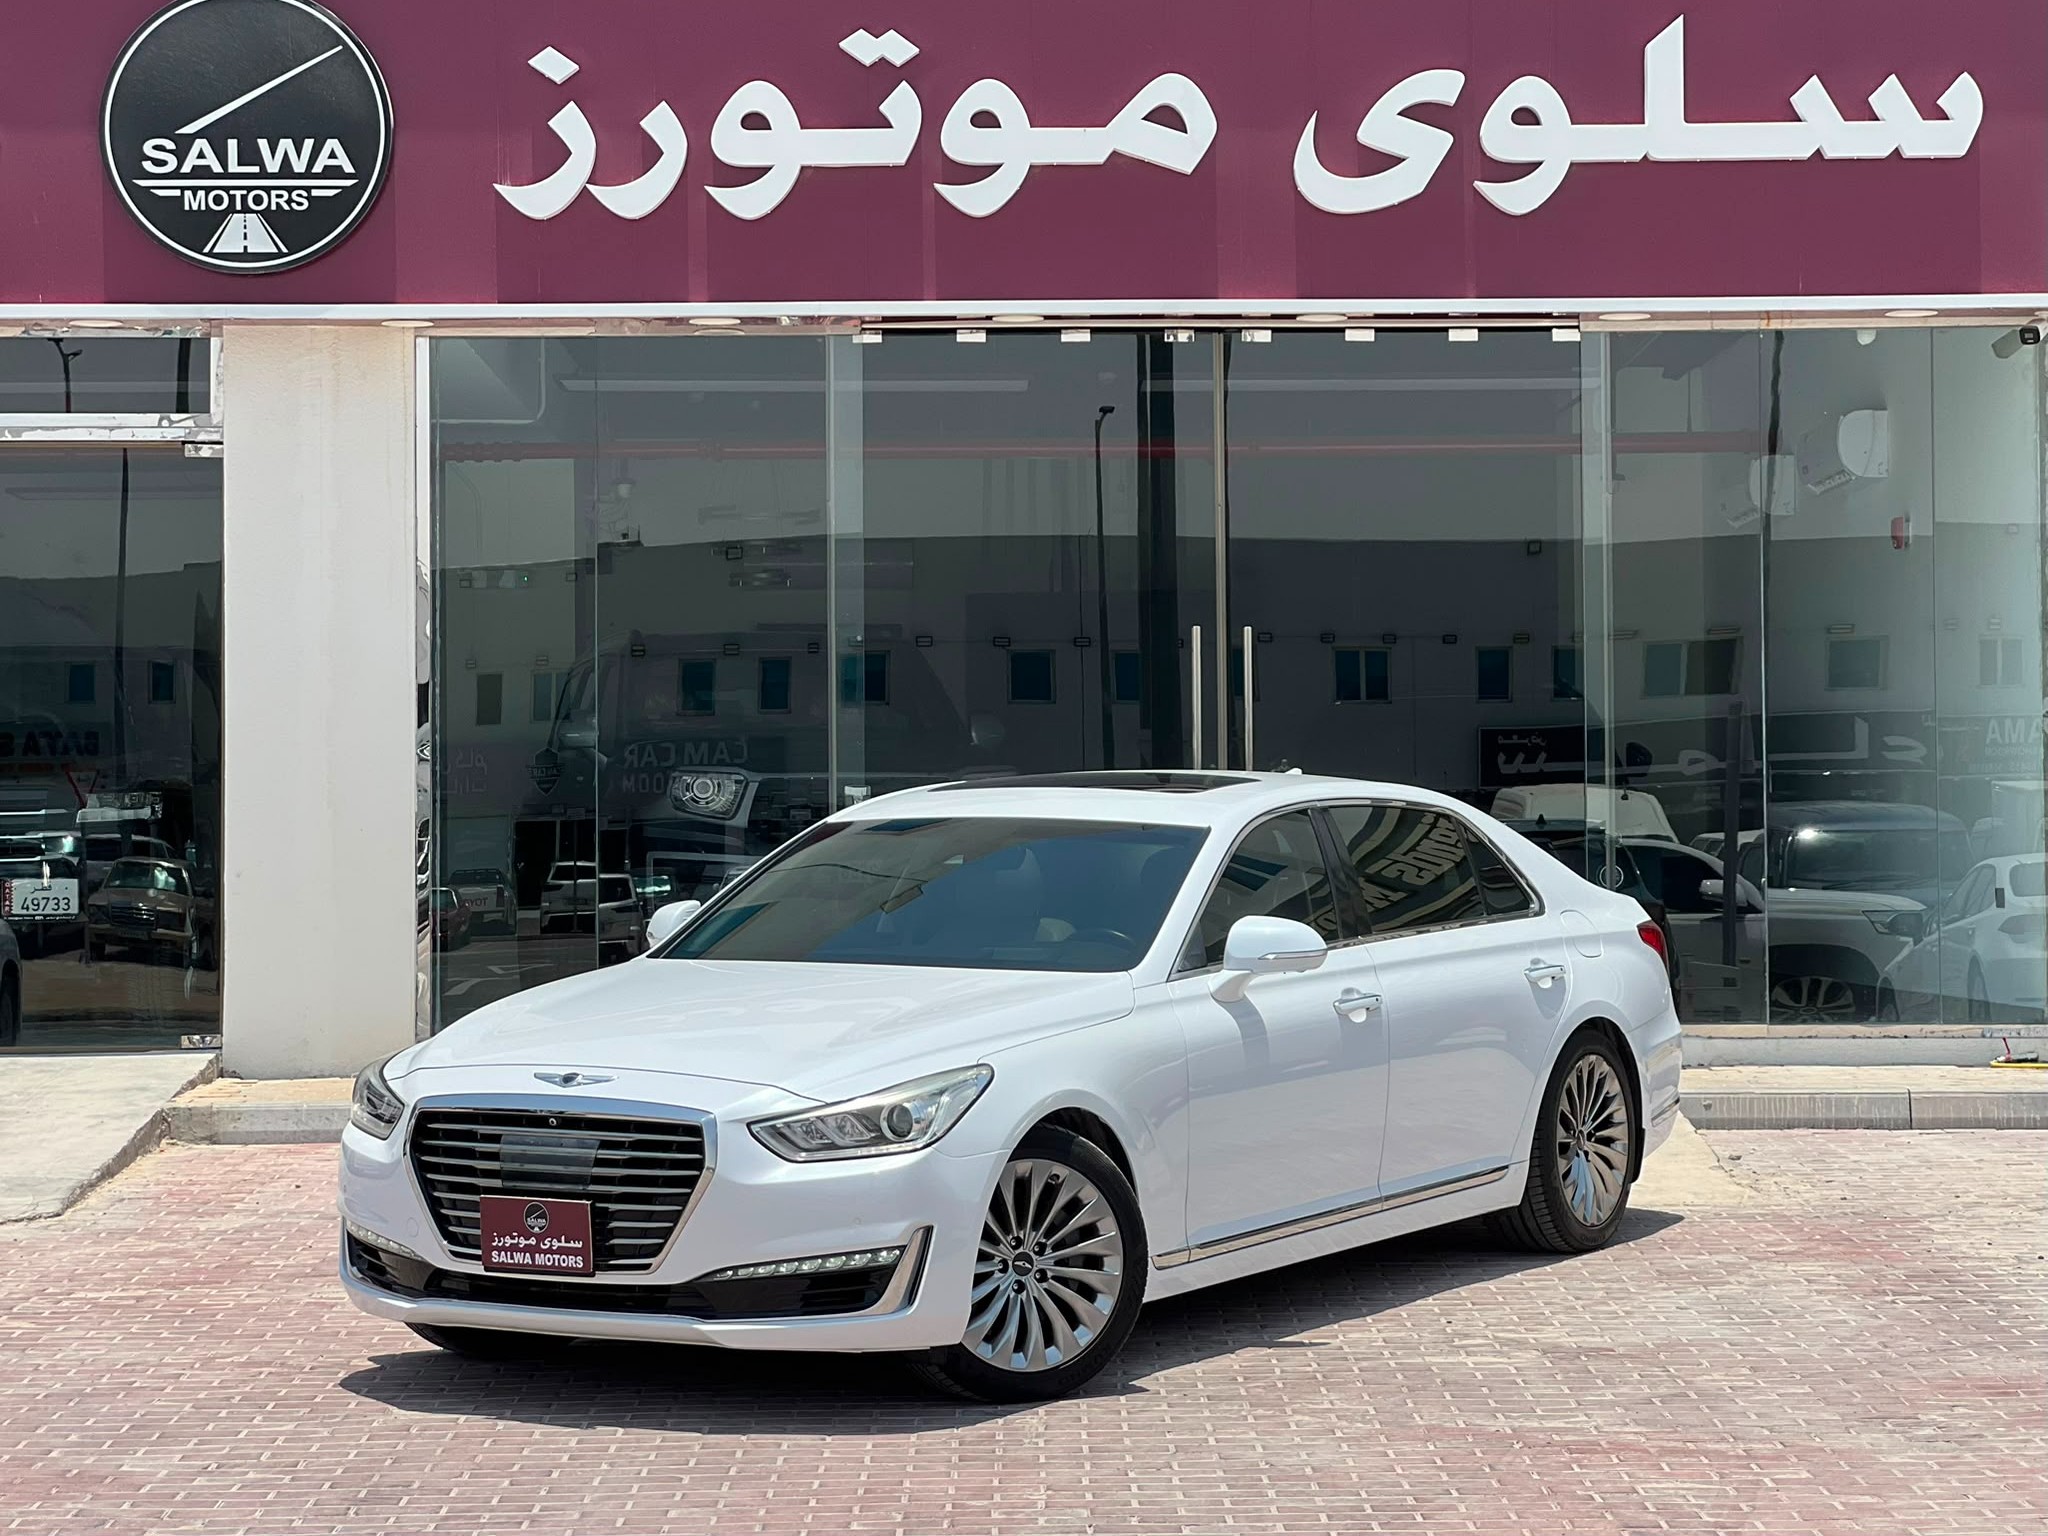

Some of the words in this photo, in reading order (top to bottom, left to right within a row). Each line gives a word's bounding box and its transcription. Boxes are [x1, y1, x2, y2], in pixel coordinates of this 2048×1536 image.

[492, 28, 1219, 221] موتورز
[1292, 13, 1985, 216] سلوى
[141, 138, 356, 174] SALWA
[183, 189, 309, 211] MOTORS
[20, 896, 71, 912] 49733
[491, 1232, 537, 1248] موتورز
[540, 1234, 583, 1250] سلوى
[491, 1250, 532, 1265] SALWA
[535, 1253, 584, 1268] MOTORS
